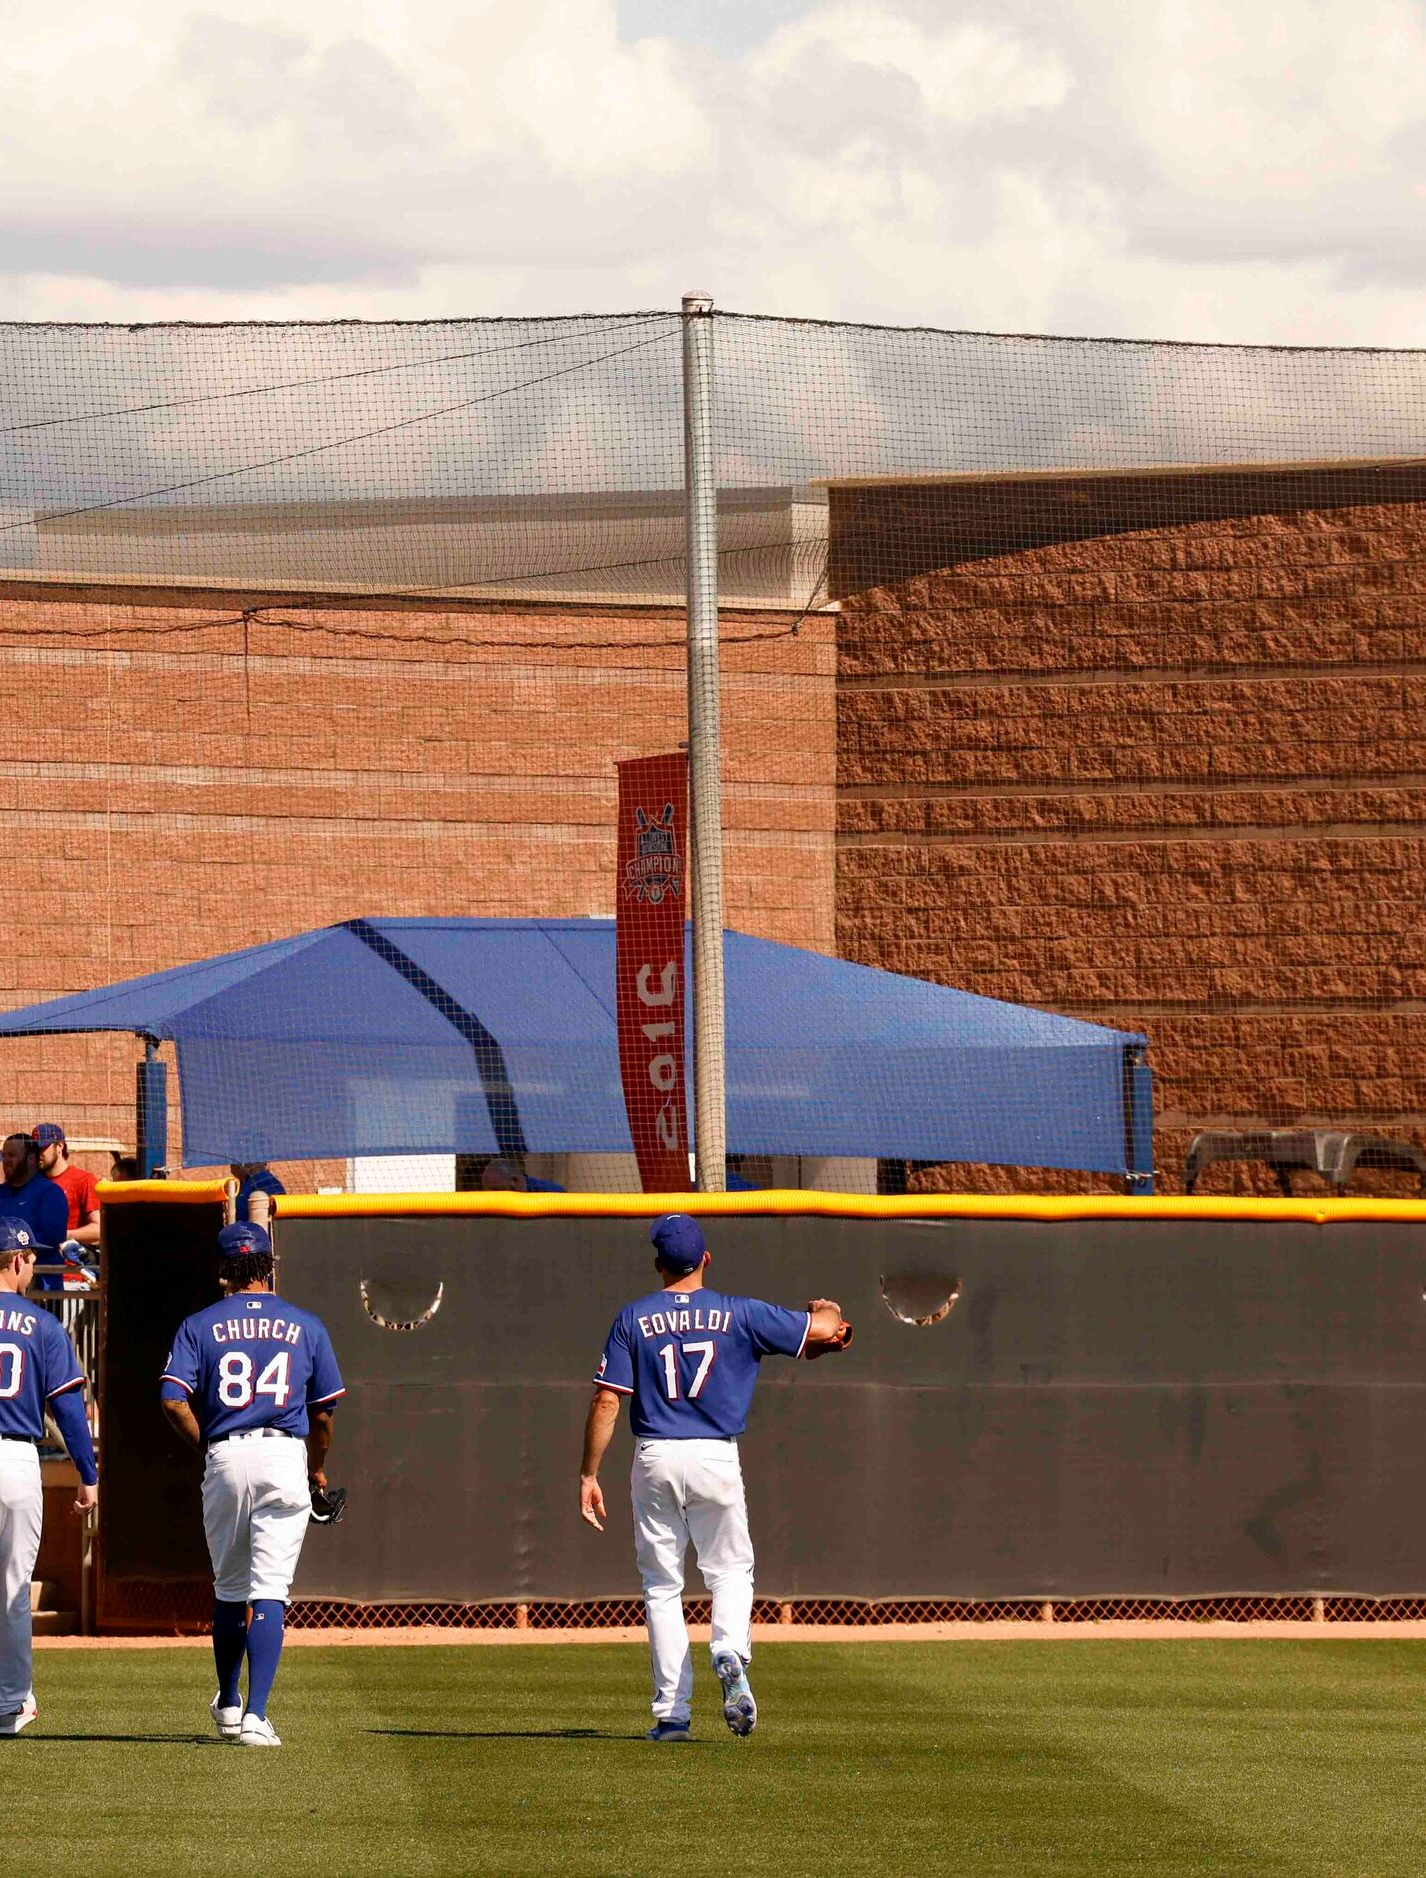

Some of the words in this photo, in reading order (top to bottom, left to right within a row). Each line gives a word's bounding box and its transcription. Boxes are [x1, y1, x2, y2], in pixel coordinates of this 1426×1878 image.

[212, 1318, 303, 1345] CHURCH
[638, 1309, 732, 1339] EOVALDI
[218, 1351, 292, 1409] 84
[659, 1340, 719, 1401] 17
